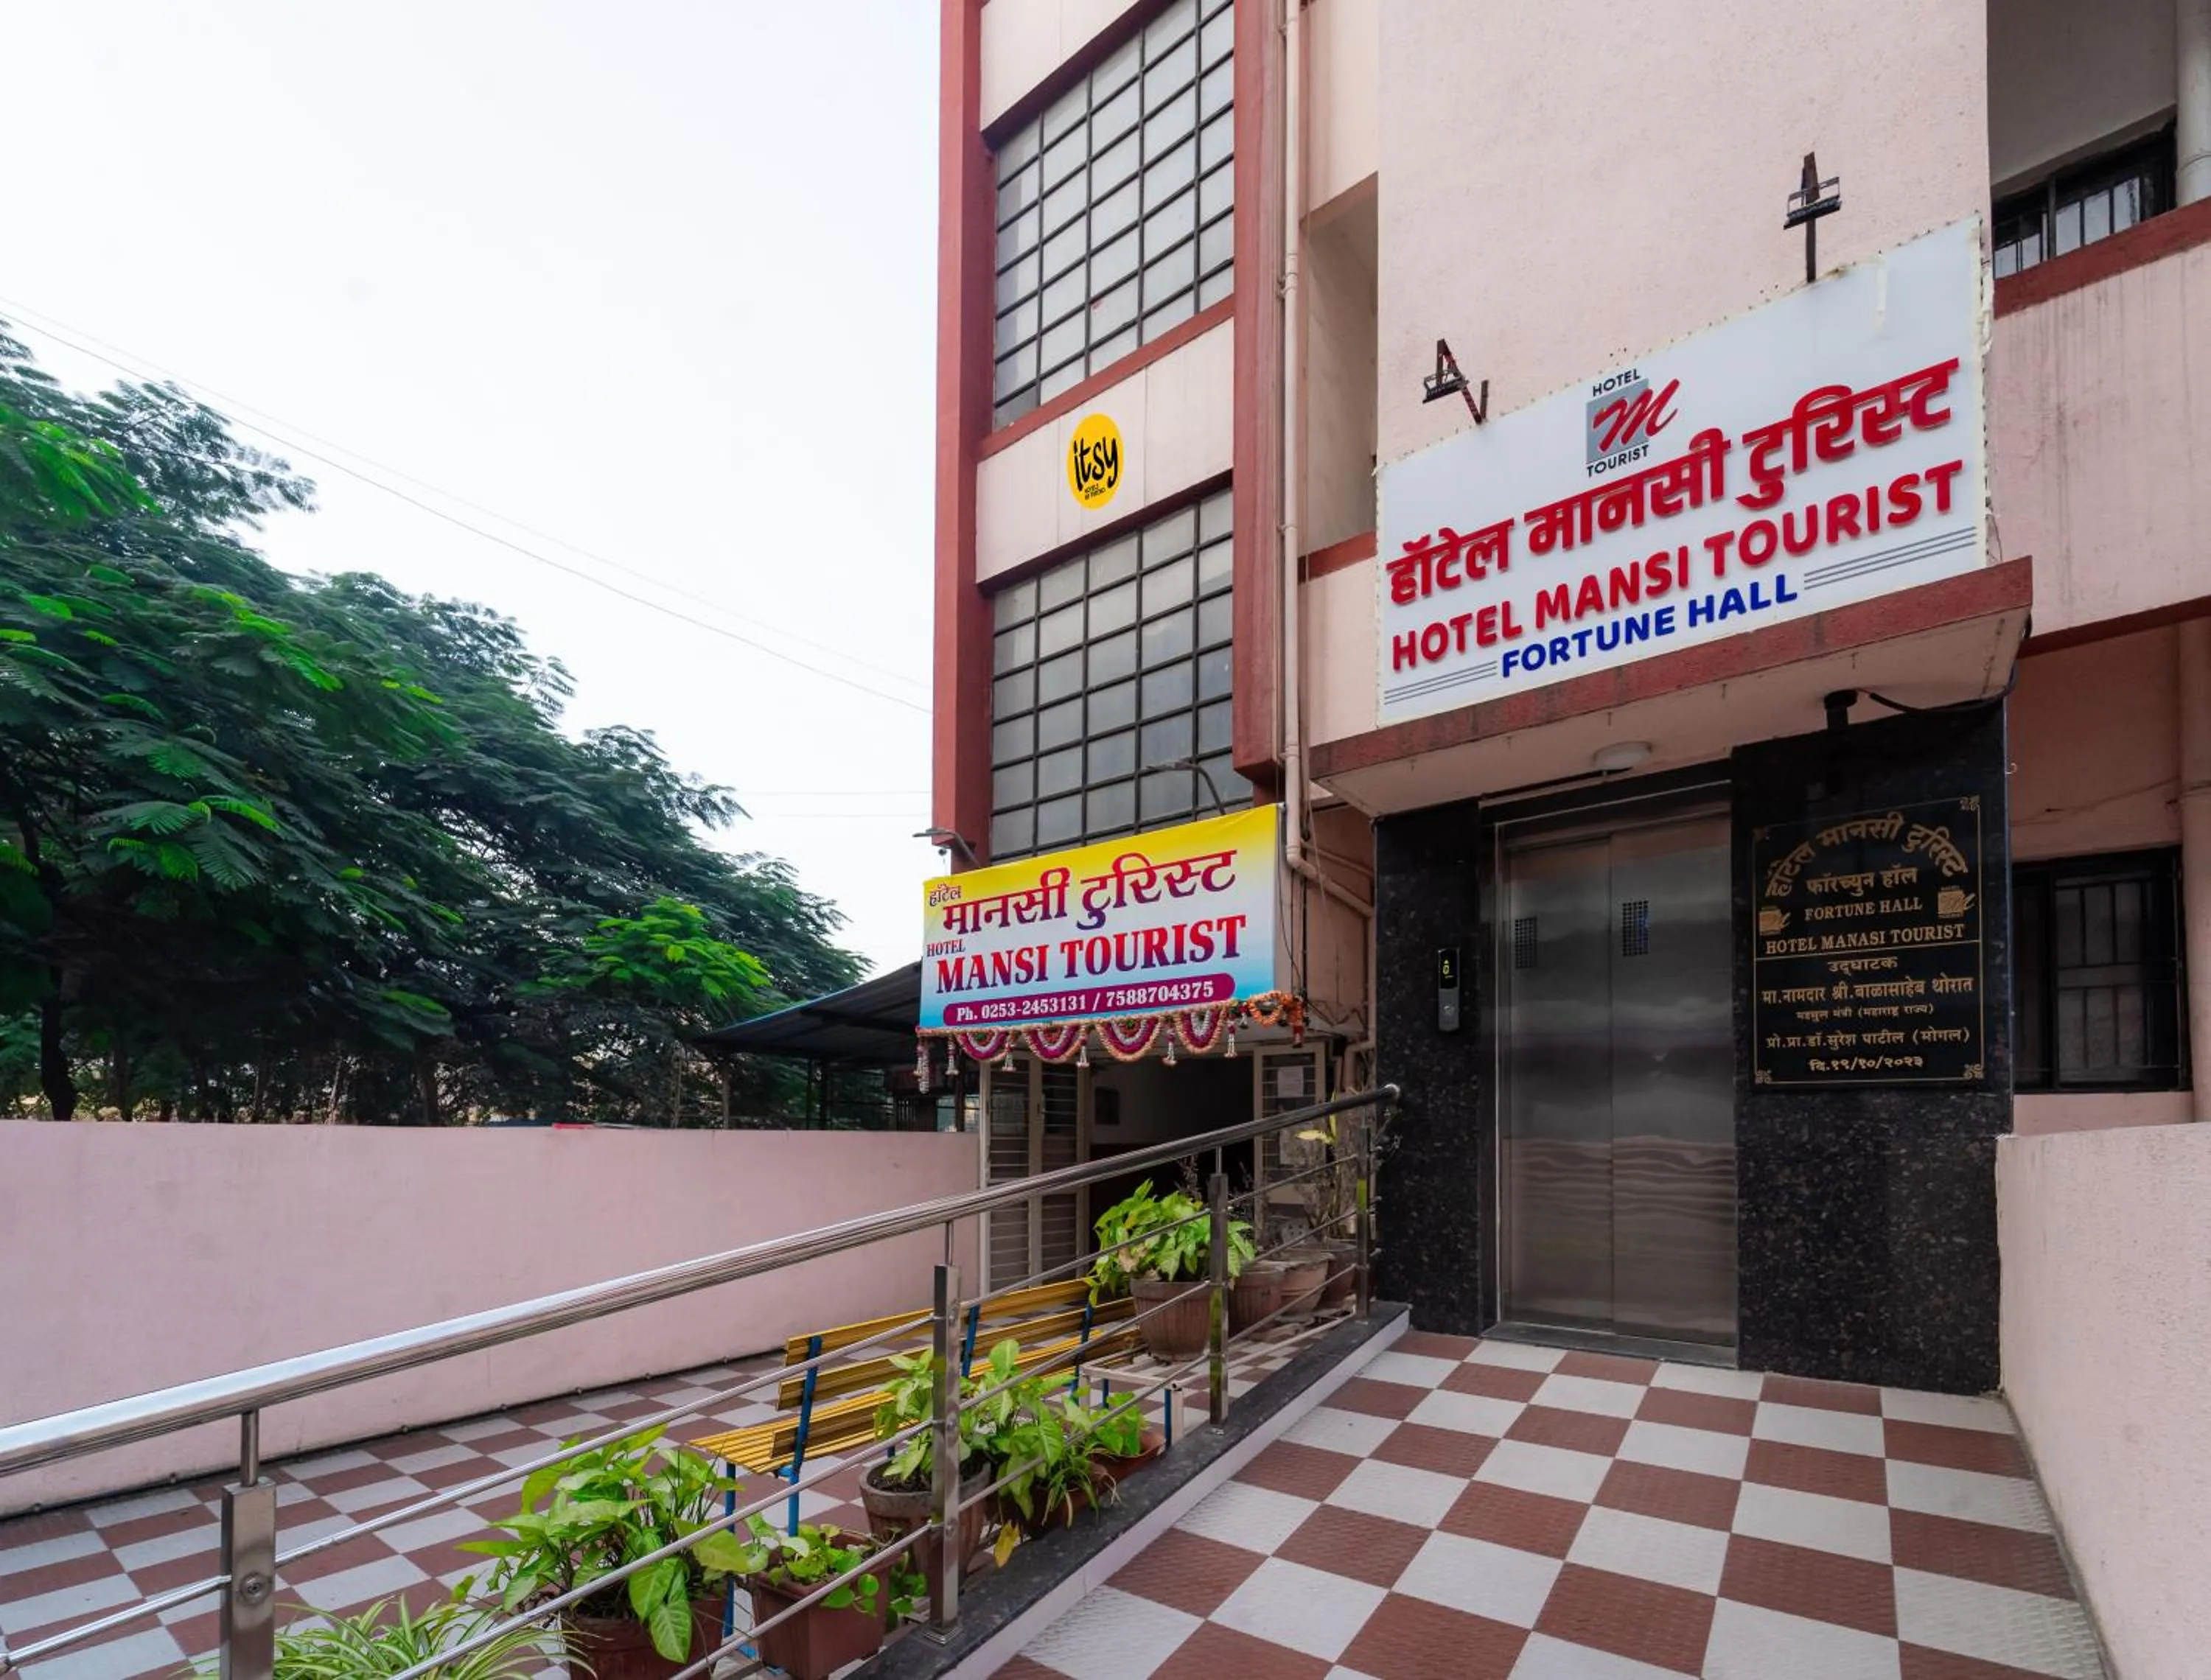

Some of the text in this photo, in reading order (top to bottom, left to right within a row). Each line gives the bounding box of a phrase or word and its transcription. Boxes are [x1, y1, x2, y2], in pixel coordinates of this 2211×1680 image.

[1593, 368, 1641, 396] HOTEL
[1587, 444, 1649, 477] TOURIST
[1386, 357, 1960, 604] हॉटेल मानसी टुरिस्ट
[1392, 460, 1963, 671] HOTEL MANSI TOURIST
[1501, 574, 1798, 678] FORTUNE HALL
[1816, 811, 1904, 847] मानसी
[1901, 823, 1969, 877] टुरिस्ट
[943, 850, 1237, 935] मानसी टुरिस्ट
[1880, 864, 1918, 886] हॉल
[1804, 897, 1922, 921] FORTUNE HALL
[926, 939, 965, 957] HOTEL
[936, 914, 1246, 993] MANSI TOURIST
[1765, 923, 1965, 955] HOTEL MANASI TOURIST
[957, 1005, 978, 1021] Ph.
[981, 994, 1086, 1020] 0253-2453131
[1106, 981, 1215, 1007] 7588704375
[1862, 1029, 1904, 1045] पाटील
